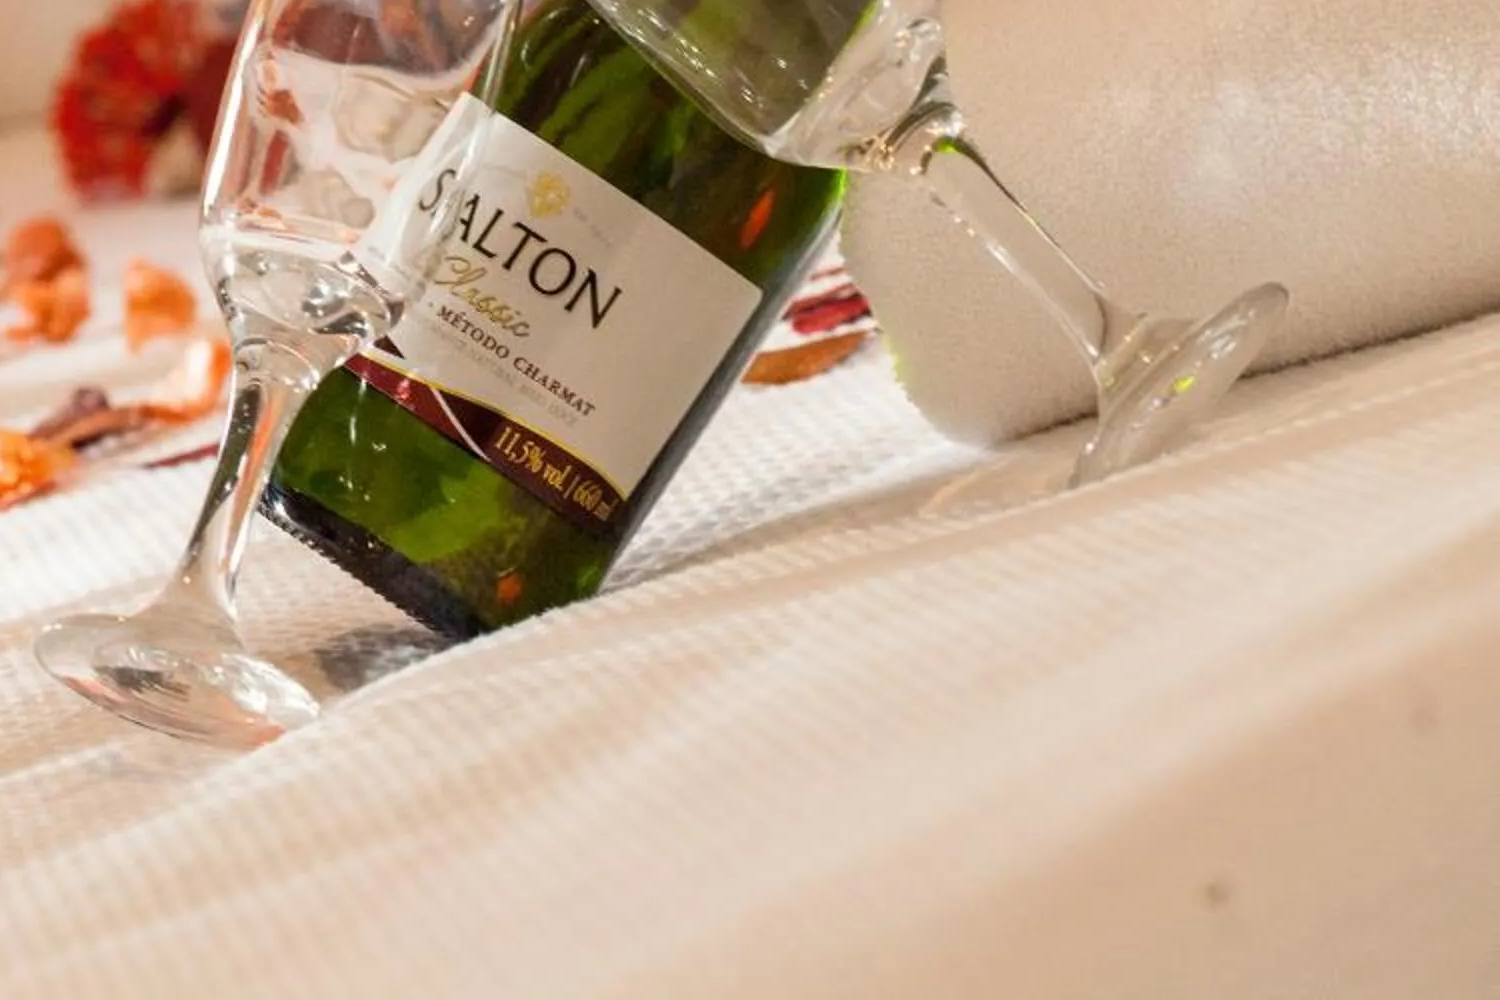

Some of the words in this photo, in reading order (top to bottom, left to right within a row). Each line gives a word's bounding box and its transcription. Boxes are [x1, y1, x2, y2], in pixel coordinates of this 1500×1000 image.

[418, 168, 622, 330] SALTON
[436, 305, 511, 359] MÉTODO
[512, 356, 597, 417] CHARMAT
